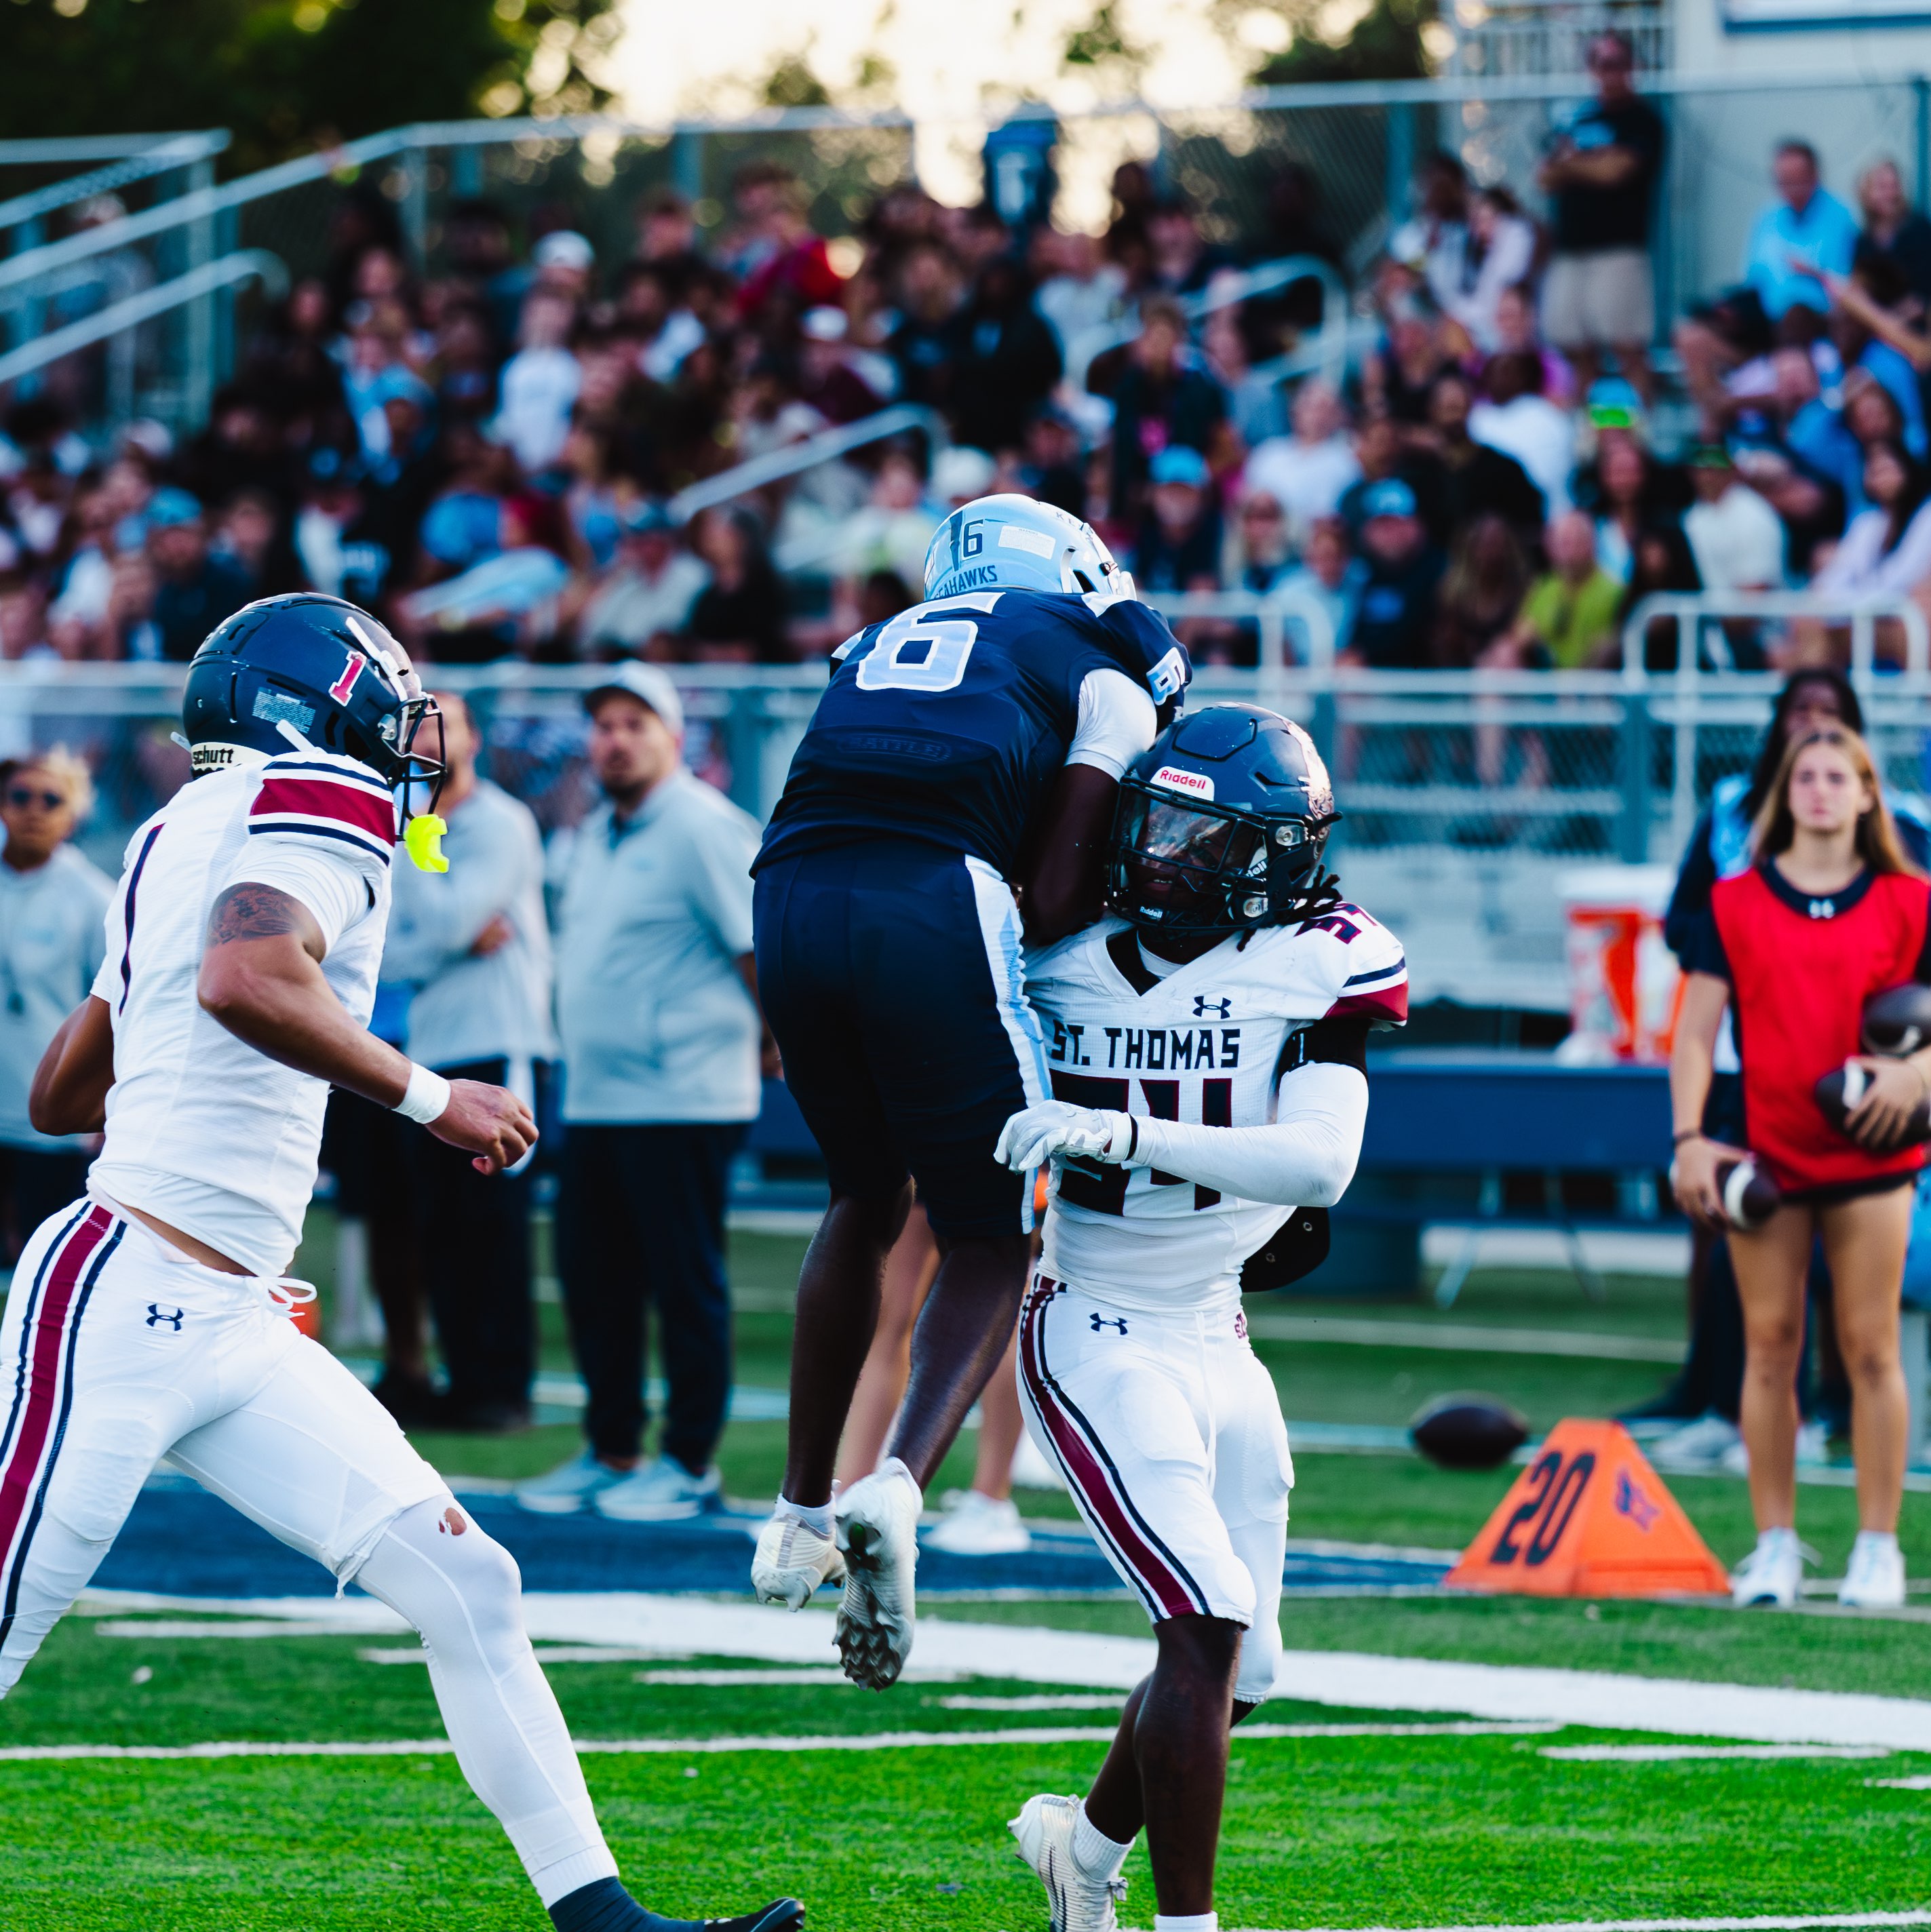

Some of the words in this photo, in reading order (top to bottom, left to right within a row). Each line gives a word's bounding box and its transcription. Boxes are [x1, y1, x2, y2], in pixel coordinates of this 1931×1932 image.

[962, 519, 984, 561] 6
[856, 592, 1007, 692] 6
[329, 651, 367, 706] 1
[1146, 647, 1186, 705] 6
[193, 745, 234, 765] schutt
[1160, 770, 1206, 790] Riddell
[1051, 1019, 1091, 1066] ST.
[1103, 1027, 1241, 1069] THOMAS
[1490, 1451, 1596, 1566] 20
